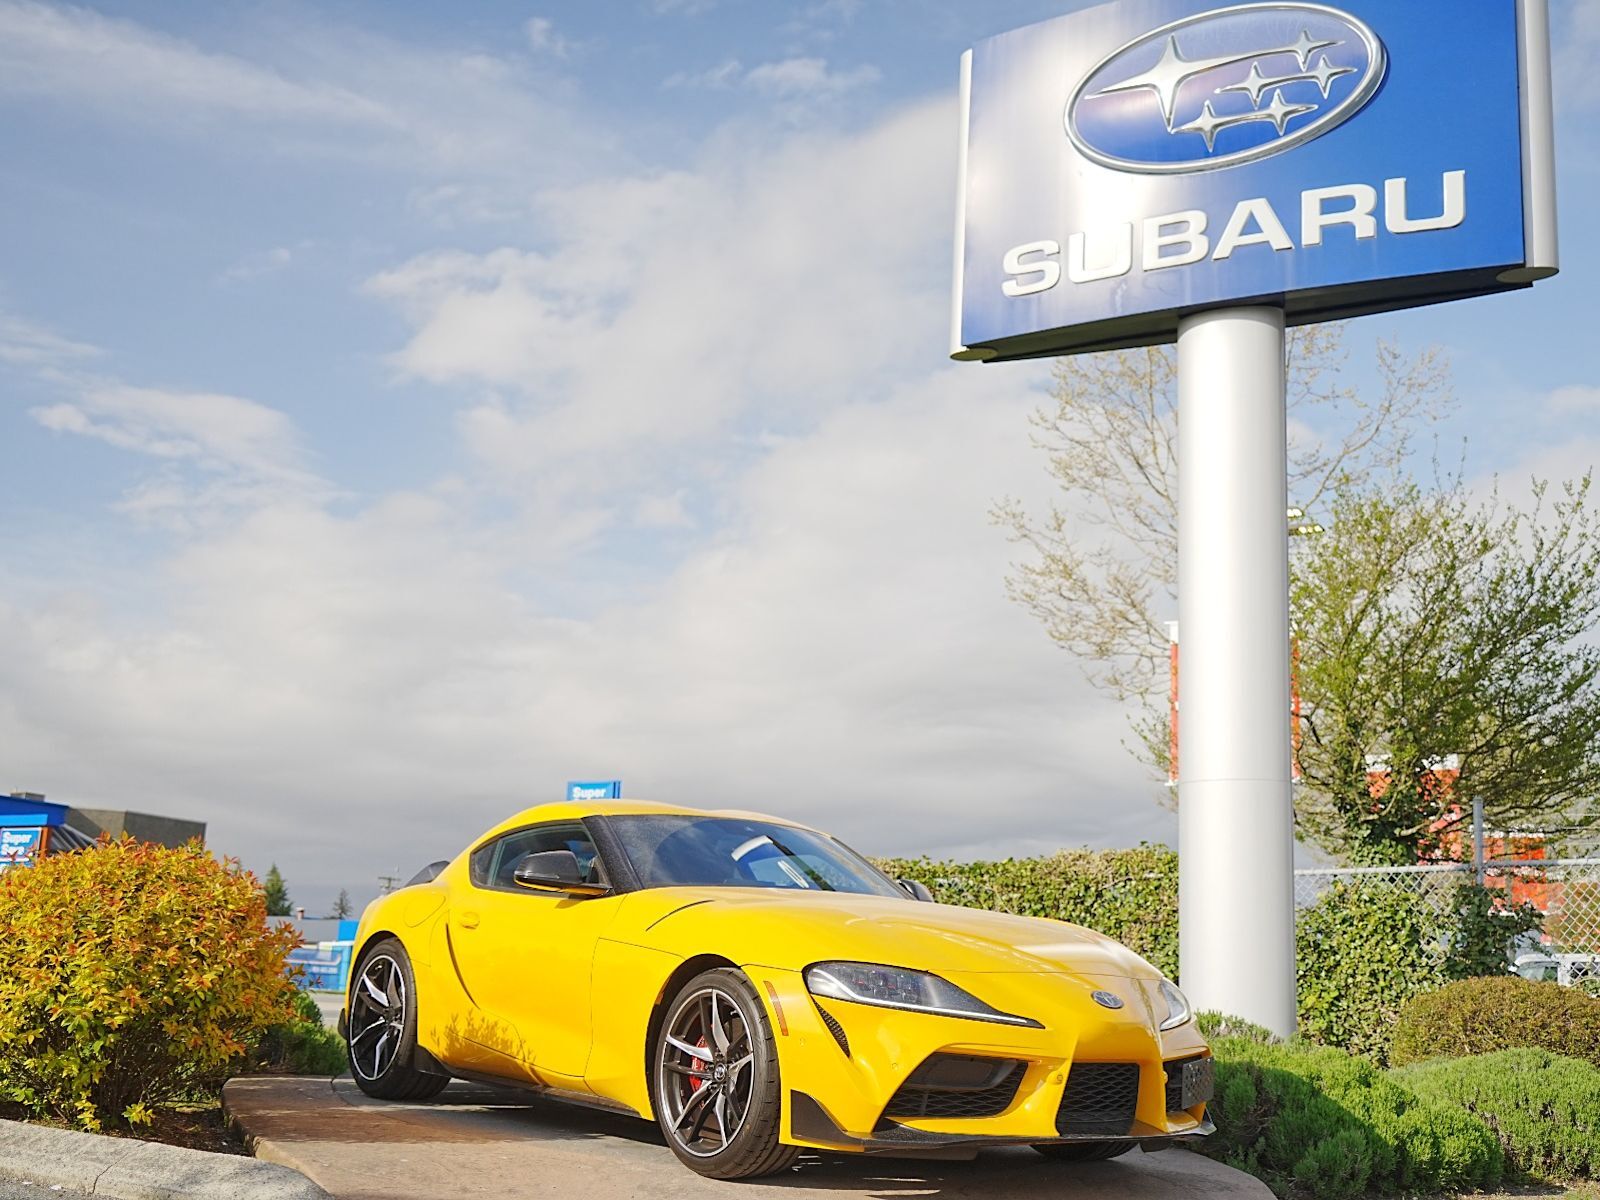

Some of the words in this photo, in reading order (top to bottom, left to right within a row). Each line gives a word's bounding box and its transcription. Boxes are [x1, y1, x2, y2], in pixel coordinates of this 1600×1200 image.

[1001, 169, 1466, 298] SUBARU
[573, 787, 606, 800] Super
[2, 831, 32, 845] Super
